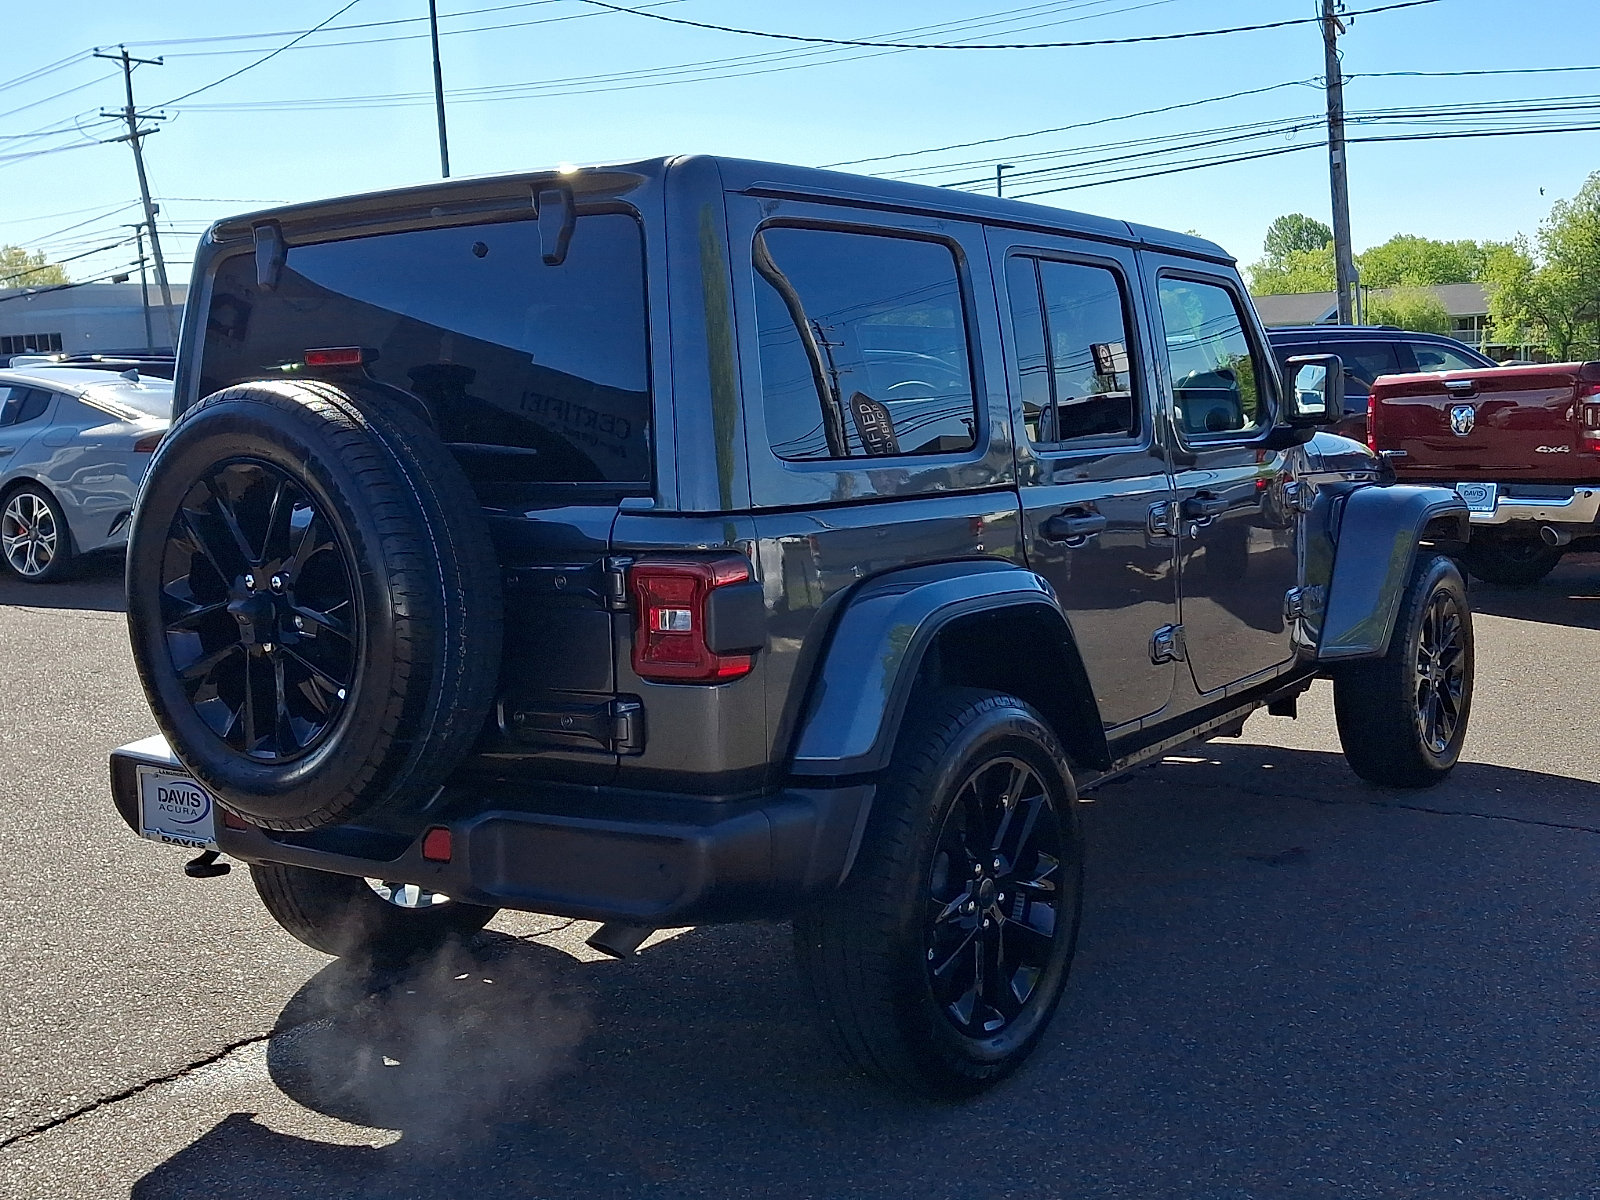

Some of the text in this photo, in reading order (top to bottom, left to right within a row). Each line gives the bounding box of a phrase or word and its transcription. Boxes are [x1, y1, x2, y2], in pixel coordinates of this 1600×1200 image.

[157, 787, 201, 808] DAVIS
[158, 803, 198, 817] ACURA
[161, 835, 206, 849] DAVIS
